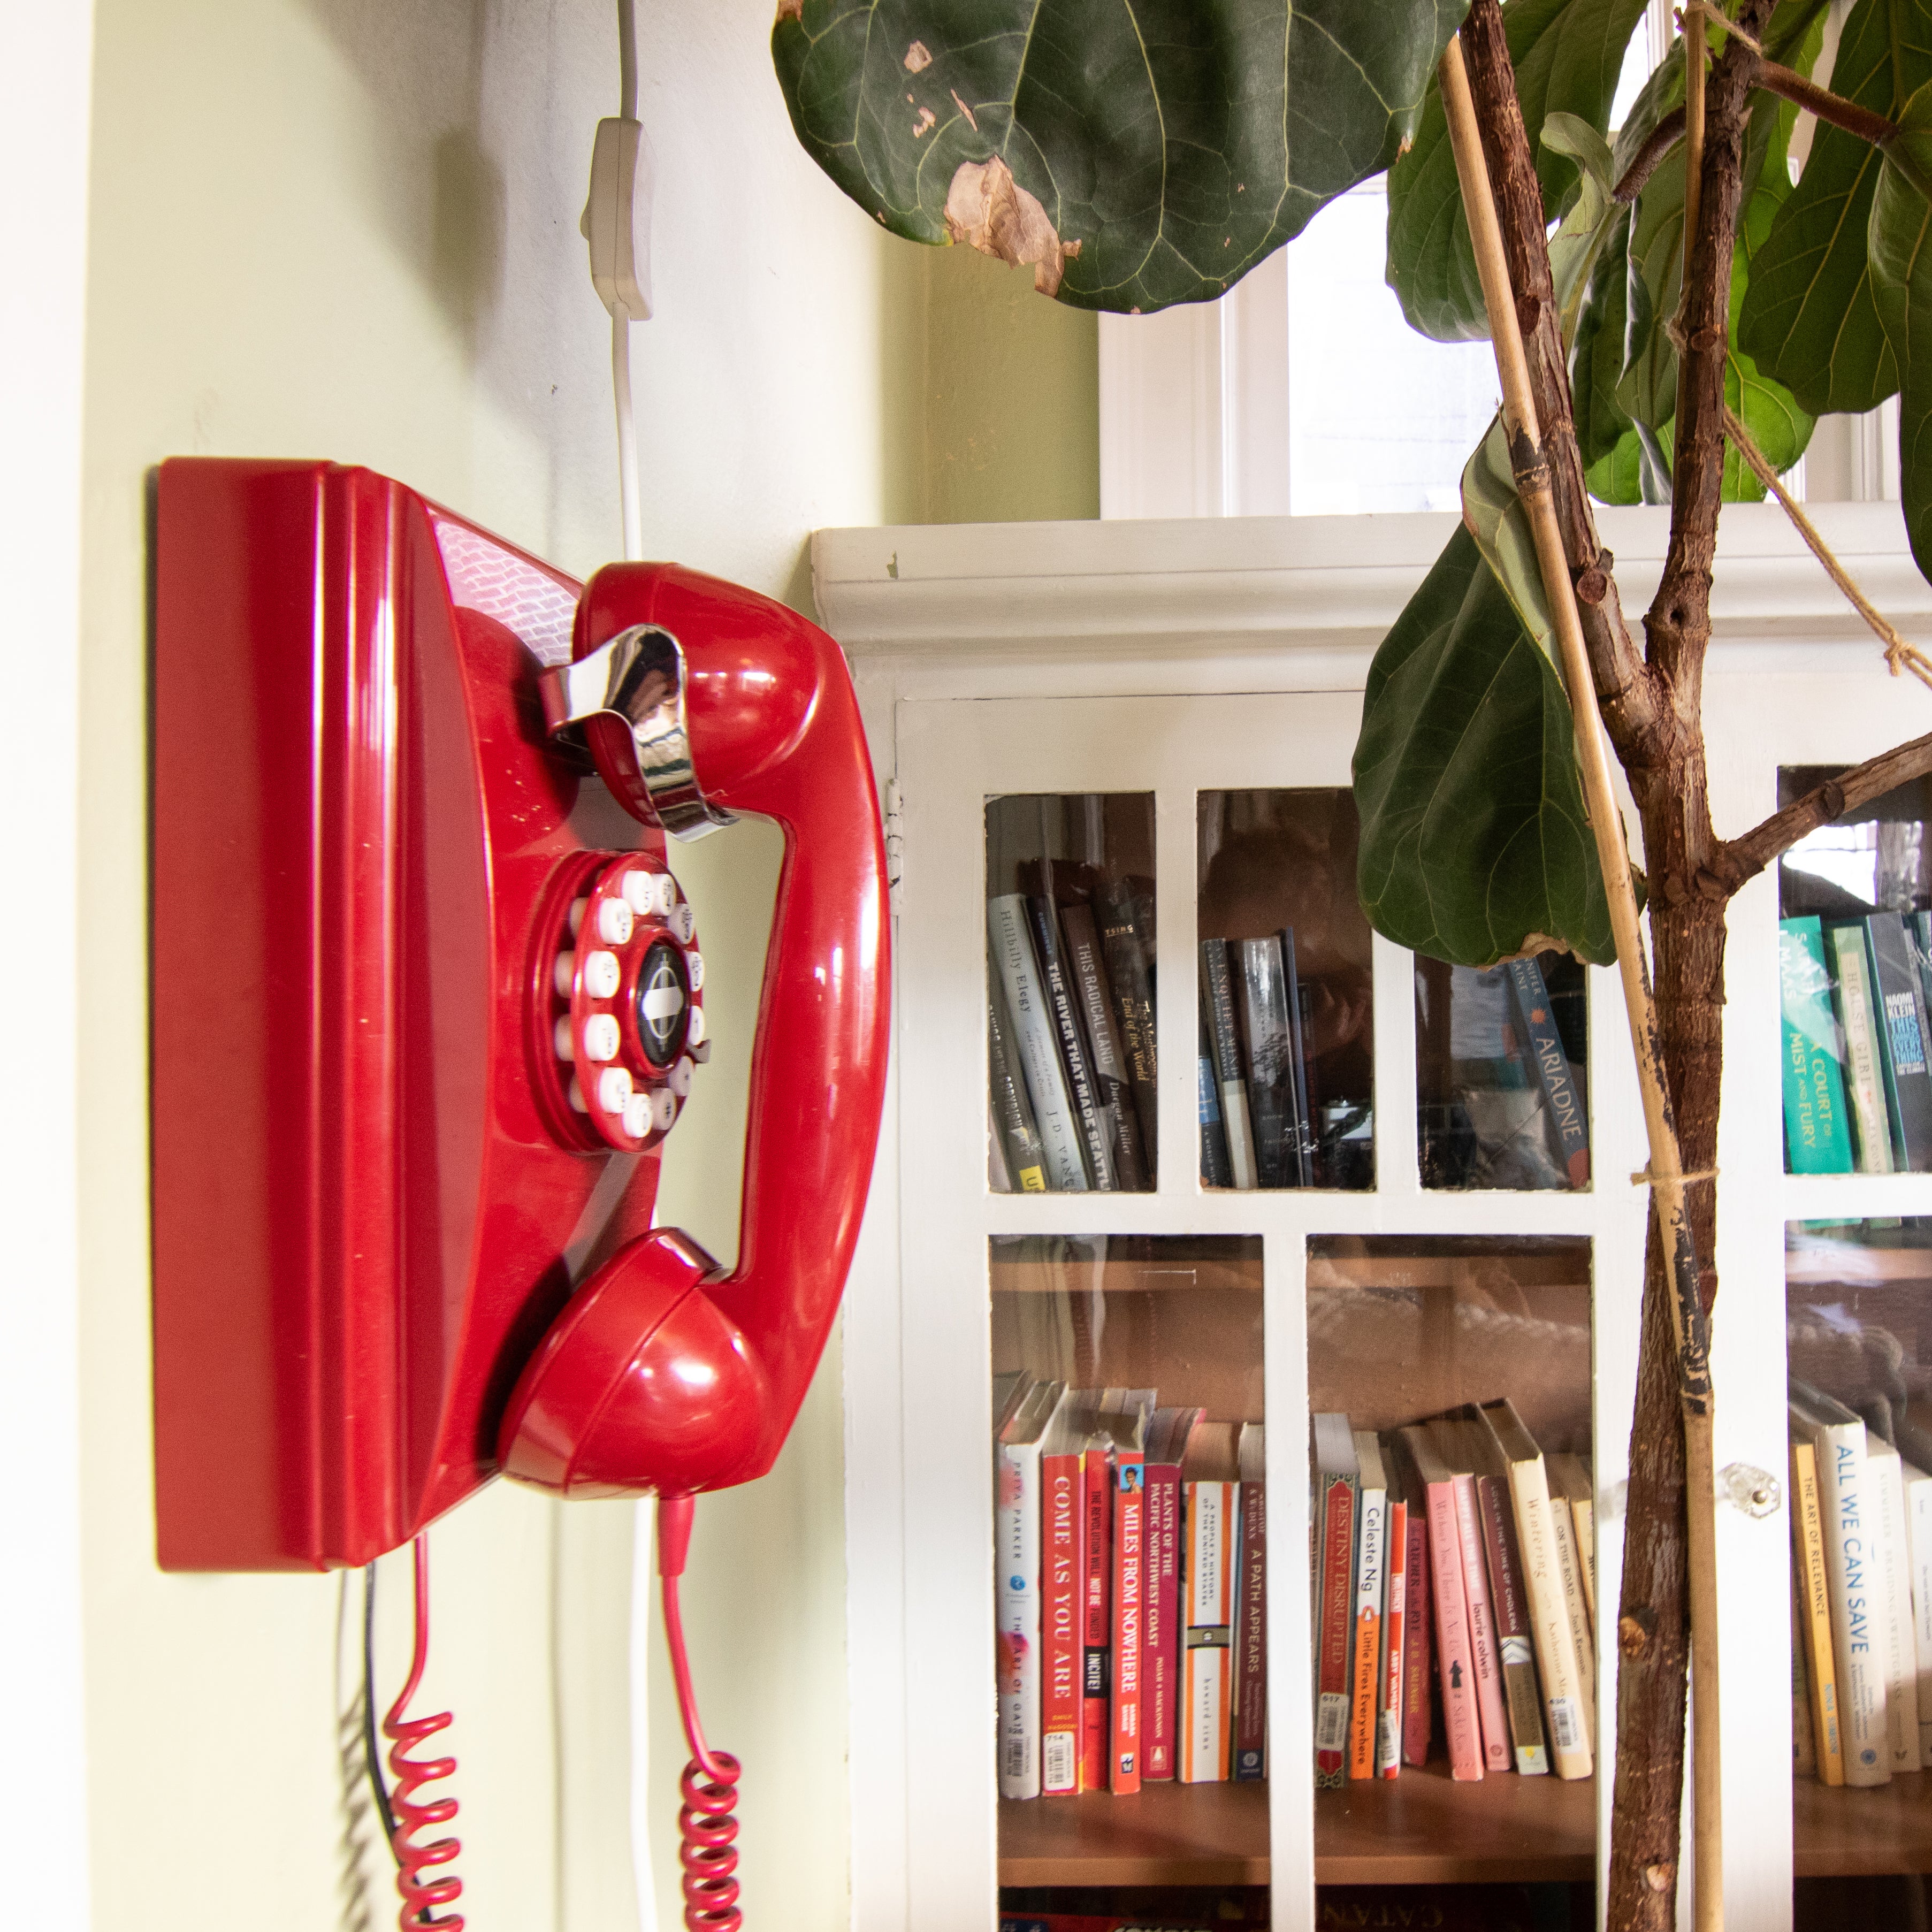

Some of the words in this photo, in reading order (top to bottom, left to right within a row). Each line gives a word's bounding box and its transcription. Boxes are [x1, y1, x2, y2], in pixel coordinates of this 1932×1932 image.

[1001, 911, 1023, 969] Hillbilly
[1015, 975, 1032, 1013] Elegy
[1078, 942, 1095, 972] THIS
[1778, 946, 1798, 1000] MAAS
[1048, 961, 1064, 994] THE
[1055, 994, 1074, 1040] RIVER
[1083, 975, 1106, 1029] RADICAL
[1122, 997, 1135, 1019] End
[1136, 1000, 1151, 1020] The
[1885, 991, 1914, 1009] NAOMI
[1887, 1004, 1916, 1021] KLEIN
[1124, 1020, 1139, 1030] of
[1128, 1033, 1141, 1049] the
[1890, 1015, 1919, 1035] THIS
[1067, 1041, 1086, 1081] THAT
[1096, 1032, 1115, 1065] LAND
[1789, 1032, 1807, 1075] MIST
[1809, 1040, 1823, 1053] A
[1133, 1049, 1150, 1081] World
[1076, 1082, 1096, 1128] MADE
[1535, 1037, 1583, 1140] ARIADNE
[1798, 1077, 1808, 1101] AND
[1812, 1058, 1832, 1122] COURT
[1052, 1124, 1062, 1139] D.
[1118, 1124, 1132, 1155] Miller
[1799, 1102, 1816, 1149] FURY
[1013, 1462, 1022, 1501] PRIYA
[1836, 1445, 1855, 1487] ALL
[1090, 1490, 1102, 1505] THE
[1150, 1482, 1161, 1528] PACIFIC
[1202, 1498, 1210, 1509] OF
[1458, 1485, 1469, 1520] HAPPY
[1491, 1486, 1501, 1510] LOVE
[1804, 1476, 1815, 1500] THE
[1879, 1472, 1892, 1539] KIMMERER
[1053, 1476, 1072, 1545] COME
[1163, 1482, 1174, 1531] PLANTS
[1495, 1511, 1502, 1523] IN
[1807, 1502, 1818, 1526] ART
[1841, 1493, 1860, 1530] WE
[1013, 1509, 1022, 1559] PARKER
[1090, 1506, 1102, 1555] REVOLUTION
[1123, 1503, 1140, 1554] MILES
[1163, 1532, 1173, 1549] OF
[1335, 1496, 1350, 1567] DESTINY
[1364, 1506, 1381, 1563] Celeste
[1463, 1522, 1472, 1540] ALL
[1497, 1526, 1506, 1545] THE
[1526, 1497, 1549, 1579] Wintering
[1556, 1524, 1566, 1542] ON
[1809, 1530, 1820, 1546] OF
[1053, 1553, 1071, 1584] AS
[1148, 1531, 1160, 1606] NORTHWEST
[1162, 1551, 1173, 1577] THE
[1251, 1549, 1262, 1560] A
[1465, 1542, 1477, 1562] THE
[1500, 1547, 1509, 1571] TIME
[1559, 1544, 1571, 1564] THE
[1843, 1537, 1865, 1589] CAN
[1089, 1577, 1102, 1594] NOT
[1122, 1556, 1139, 1603] FROM
[1208, 1561, 1216, 1600] HISTORY
[1250, 1563, 1262, 1601] PATH
[1361, 1567, 1378, 1592] Ng
[1469, 1564, 1480, 1591] TIME
[1502, 1571, 1511, 1585] OF
[1563, 1567, 1576, 1597] ROAD
[1811, 1549, 1826, 1617] RELEVANCE
[1884, 1550, 1896, 1613] BRAIDING
[1053, 1593, 1071, 1641] YOU
[1089, 1594, 1102, 1606] BE
[1504, 1587, 1518, 1632] CHOLERA
[1148, 1607, 1159, 1648] COAST
[1332, 1572, 1347, 1664] DISRUPTED
[1471, 1602, 1488, 1637] laurie
[1847, 1597, 1870, 1655] SAVE
[1121, 1606, 1137, 1693] NOWHERE
[1247, 1605, 1261, 1674] APPEARS
[1361, 1630, 1374, 1660] Little
[1547, 1621, 1563, 1675] Katherine
[1013, 1649, 1023, 1671] ART
[1053, 1648, 1072, 1699] ARE
[1087, 1653, 1101, 1690] INCITE!
[1360, 1662, 1372, 1690] Fires
[1477, 1639, 1493, 1680] colwin
[1357, 1692, 1371, 1766] Everywhere
[1324, 1904, 1444, 1927] CATAN
